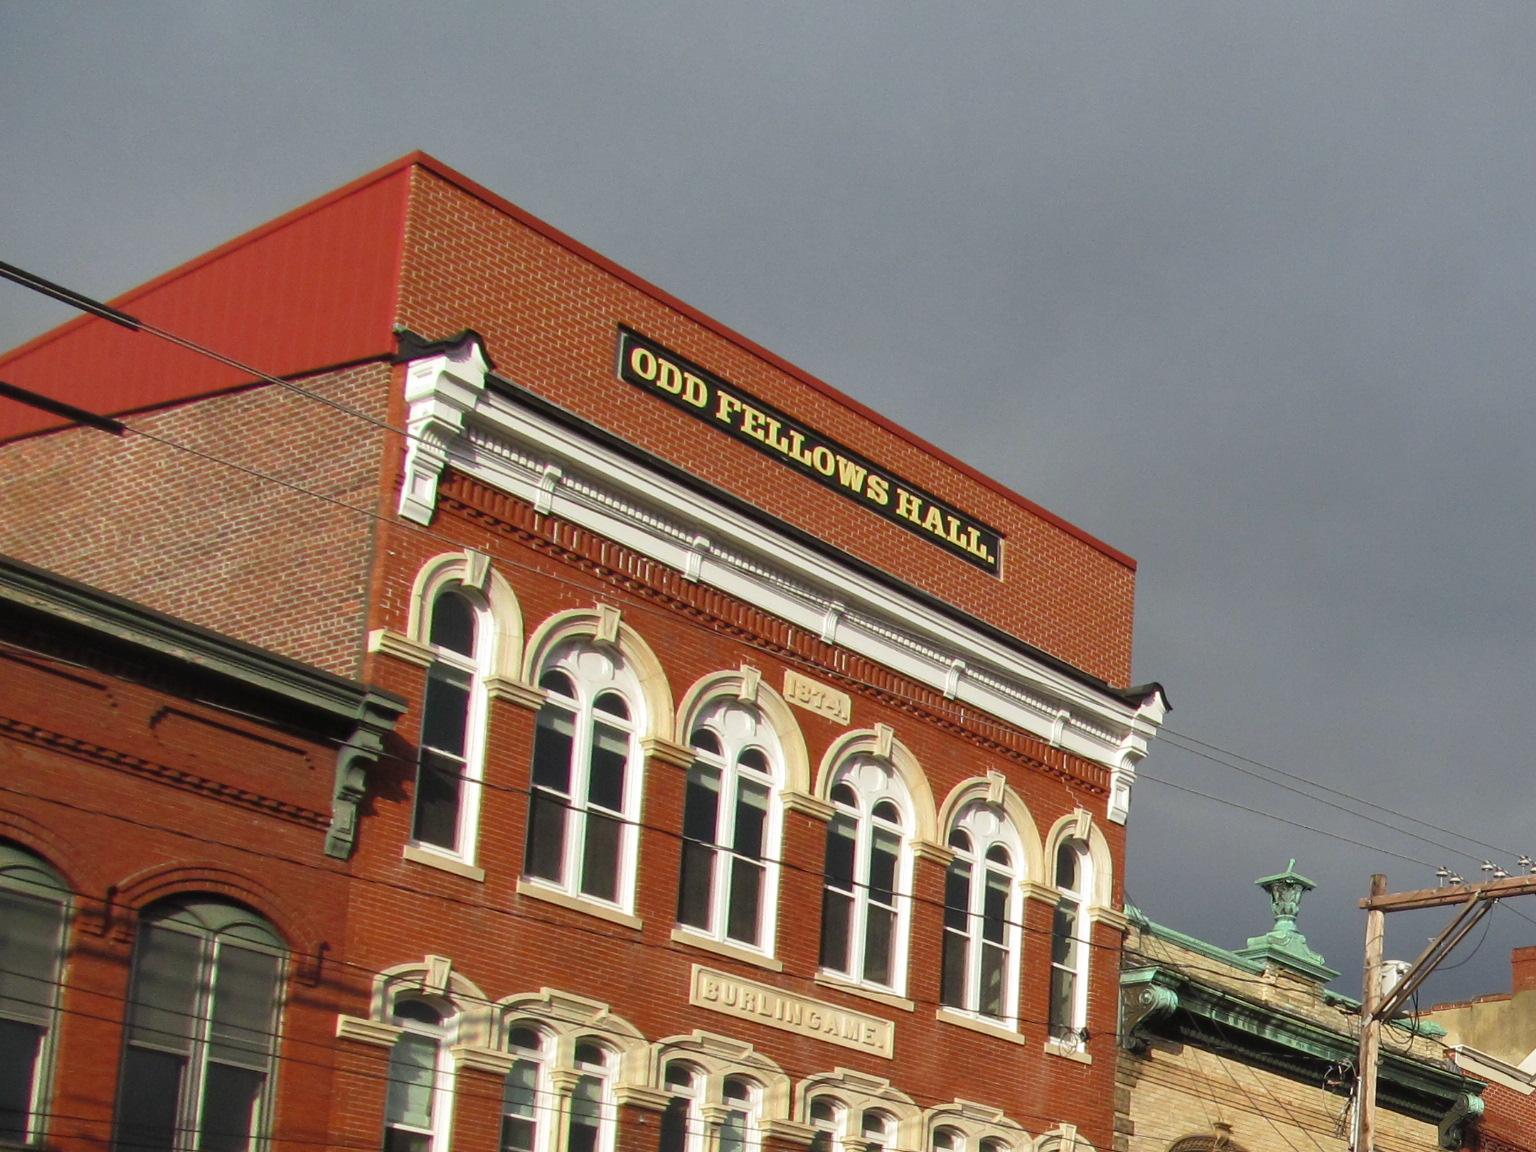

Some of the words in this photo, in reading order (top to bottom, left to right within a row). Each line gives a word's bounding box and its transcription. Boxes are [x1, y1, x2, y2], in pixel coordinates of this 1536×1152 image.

[630, 346, 708, 408] ODD
[715, 390, 889, 506] FELLOWS
[896, 487, 995, 565] HALL.
